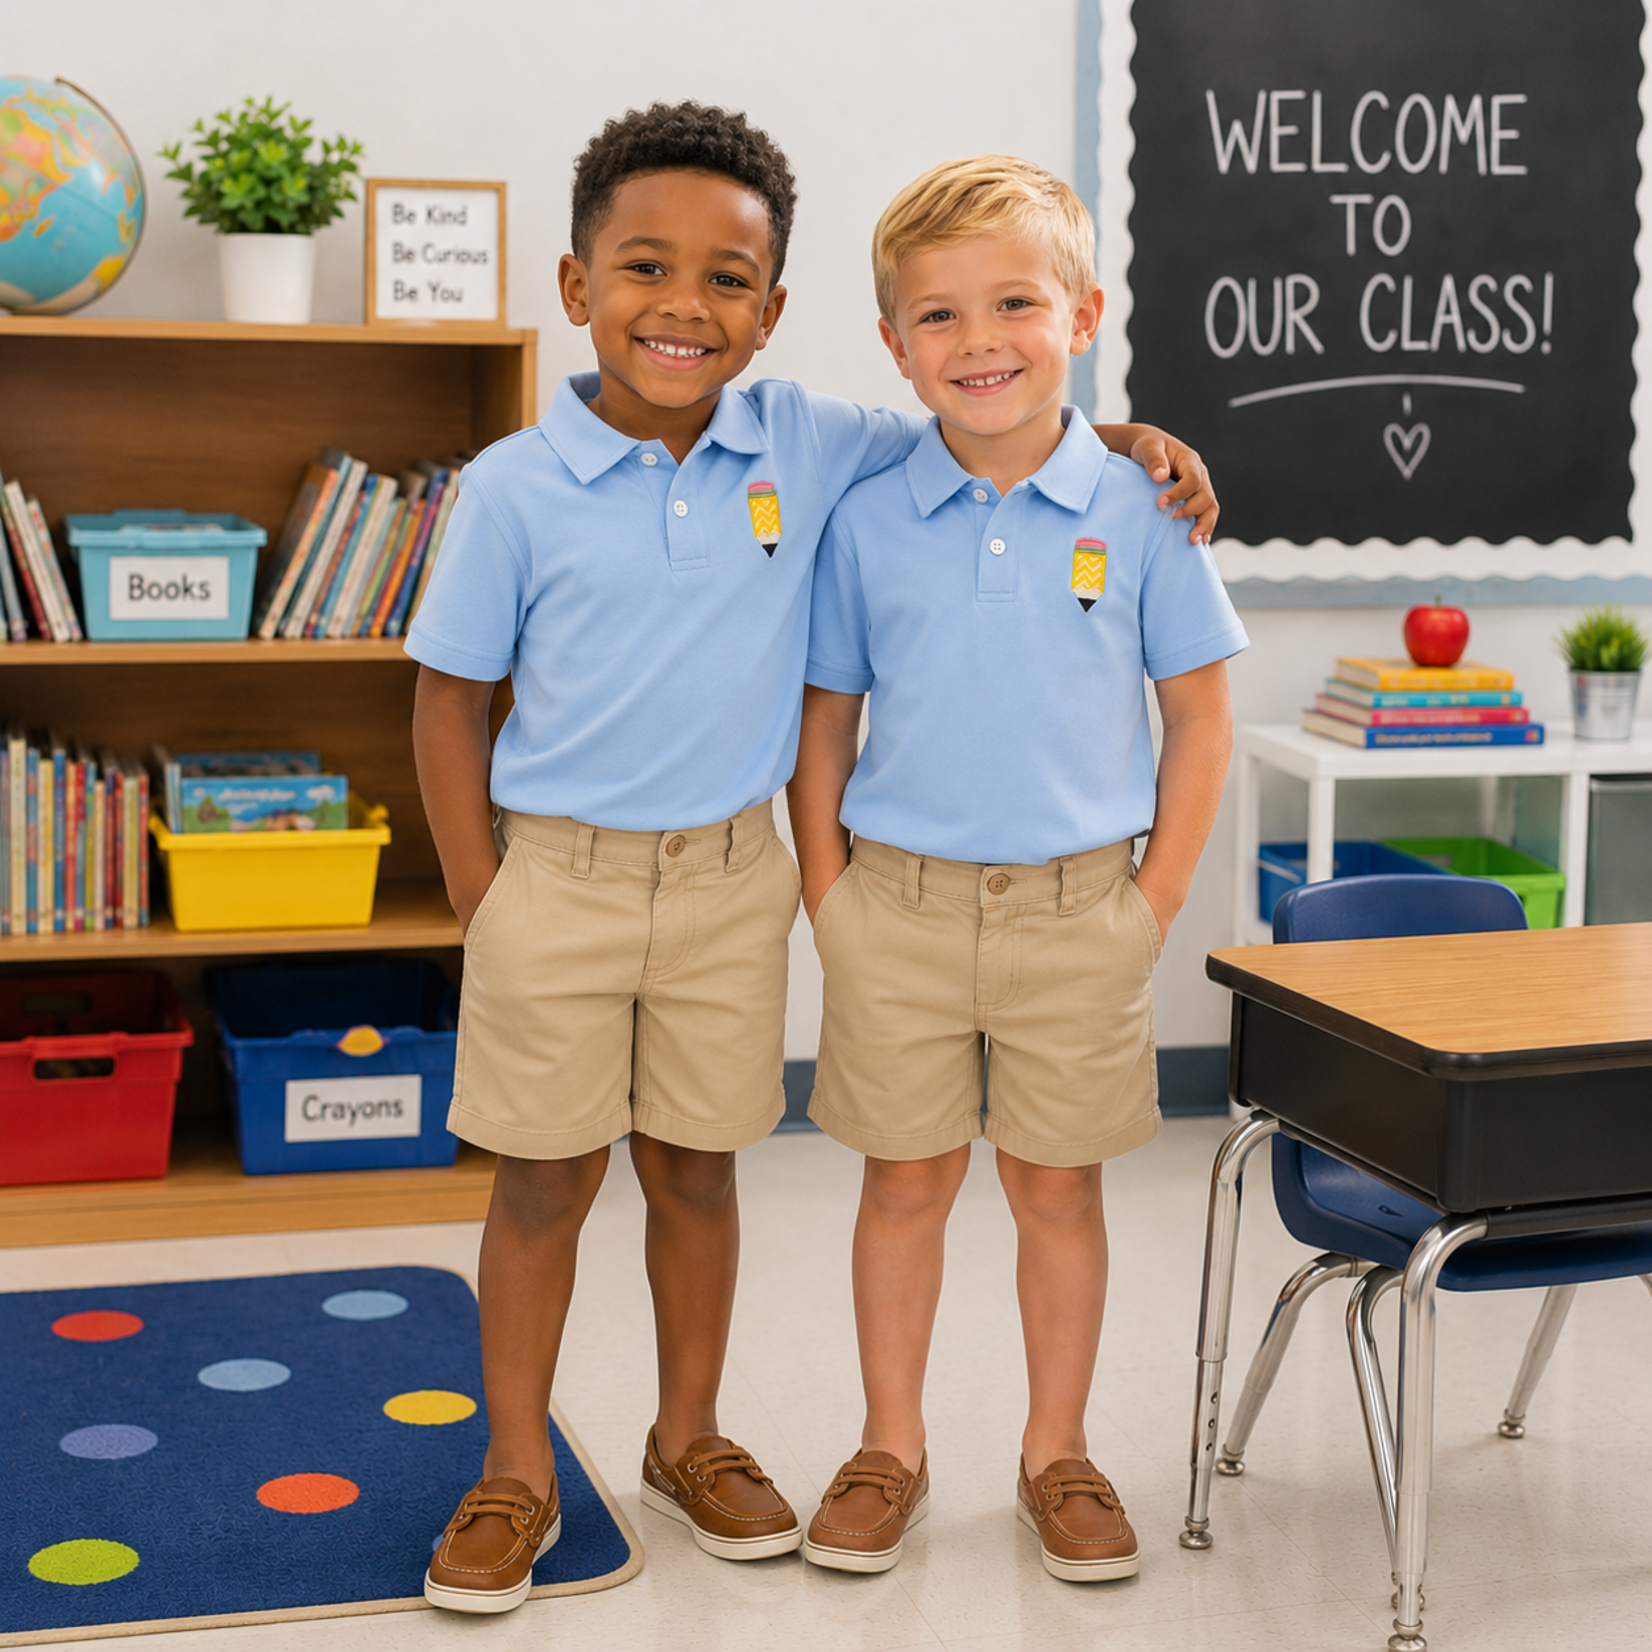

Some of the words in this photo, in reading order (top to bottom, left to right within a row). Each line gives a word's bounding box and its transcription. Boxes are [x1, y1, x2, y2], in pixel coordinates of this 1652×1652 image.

[1206, 89, 1527, 175] WELCOME
[392, 201, 416, 225] Be
[426, 203, 468, 226] Kind
[1330, 194, 1411, 256] TO
[392, 241, 416, 264] Be
[420, 242, 489, 265] Curious
[393, 279, 418, 302] Be
[427, 281, 464, 304] You
[1204, 273, 1324, 358] OUR
[1359, 272, 1554, 354] CLASS!
[128, 573, 211, 602] Books
[301, 1093, 404, 1127] Crayons
